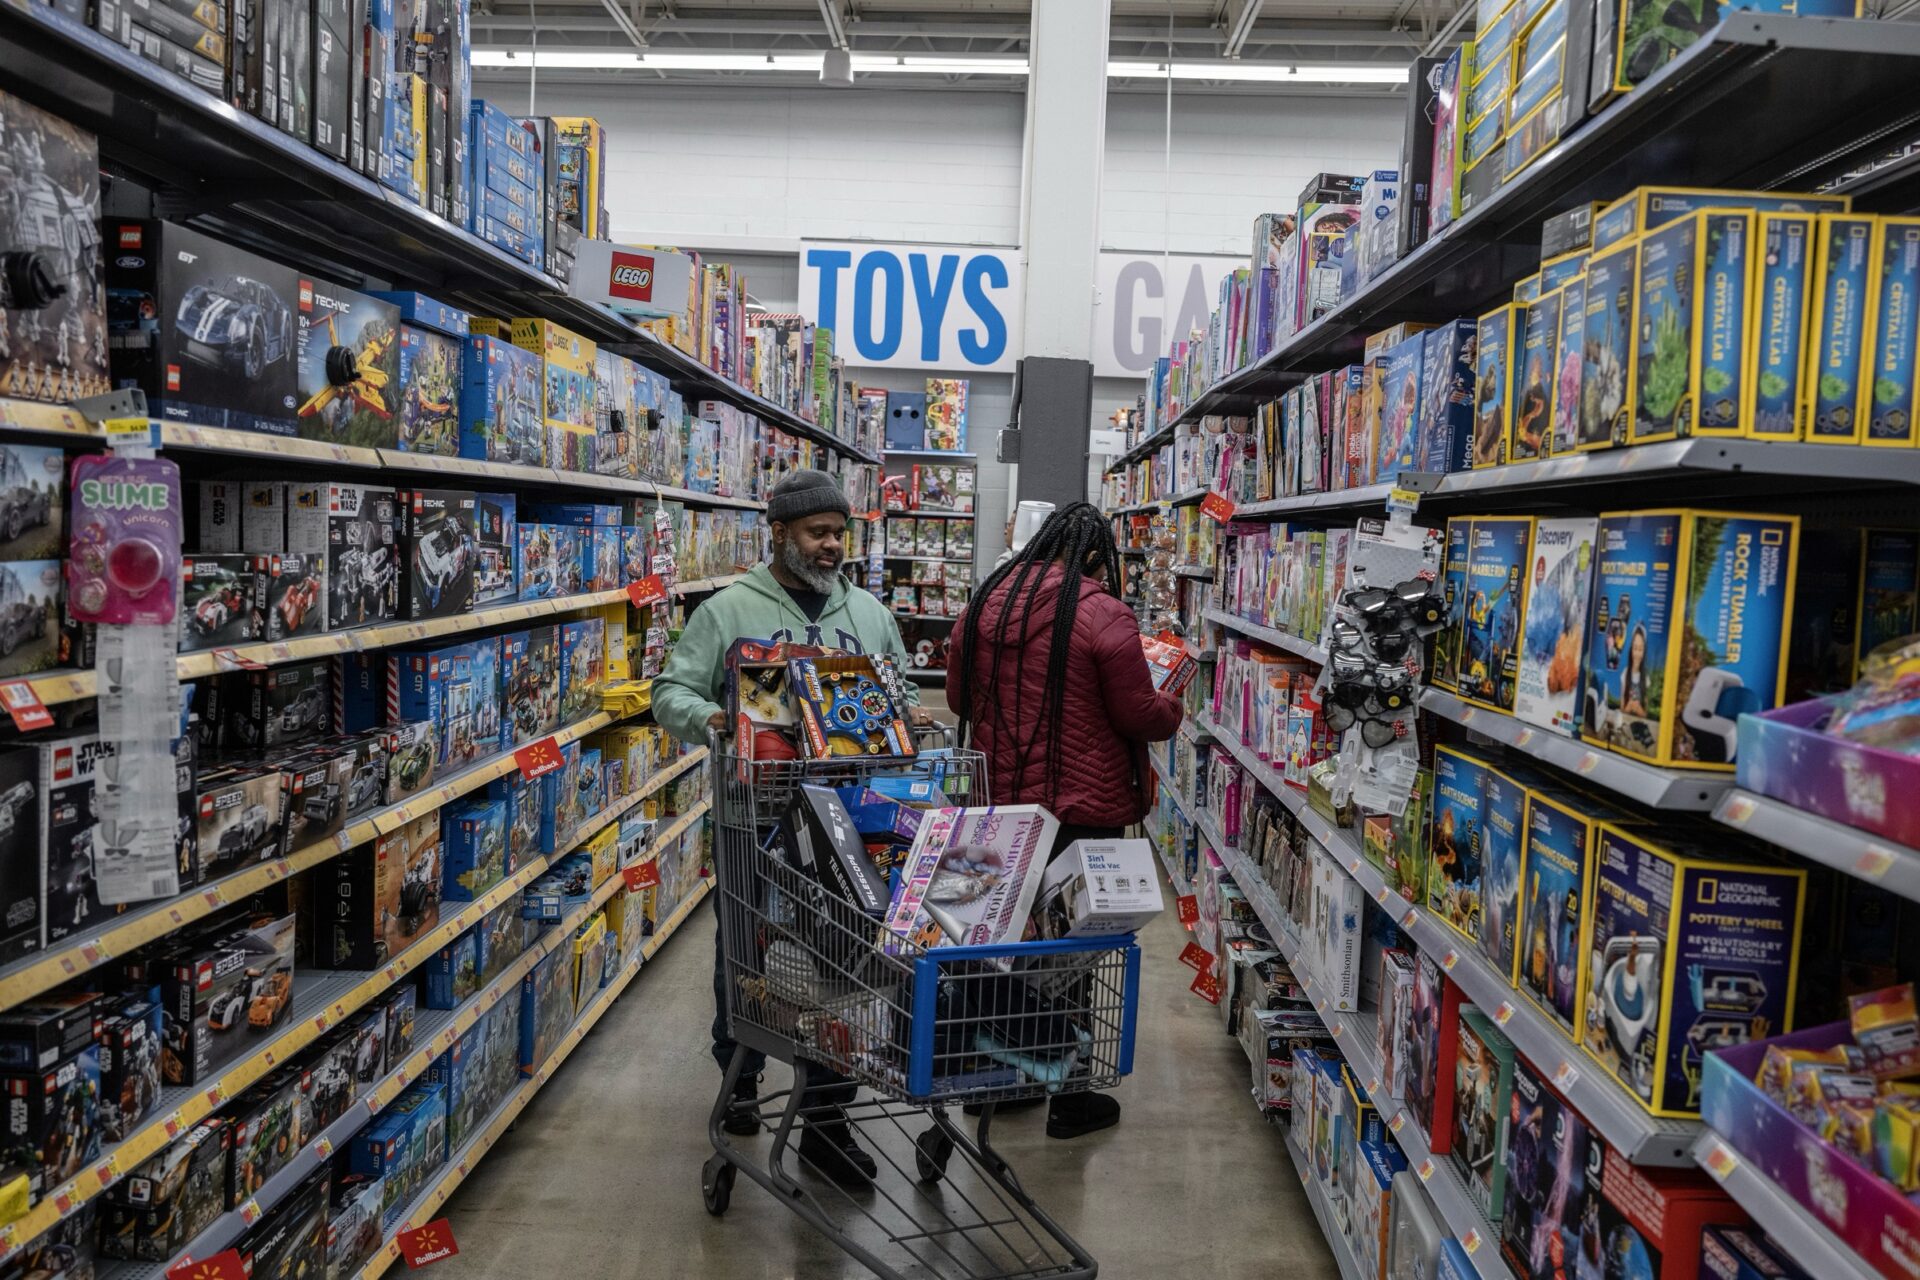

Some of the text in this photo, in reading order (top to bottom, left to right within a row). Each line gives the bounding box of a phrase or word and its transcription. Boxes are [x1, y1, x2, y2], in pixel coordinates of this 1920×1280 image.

[120, 232, 141, 241] LEGO
[178, 251, 198, 264] GT
[613, 266, 651, 288] LEGO
[315, 294, 350, 313] TECHNIC
[807, 248, 1009, 366] TOYS
[1711, 272, 1727, 361] CRYSTAL LAB
[1768, 276, 1786, 365] CRYSTAL LAB
[1830, 278, 1849, 367] CRYSTAL LAB
[1885, 282, 1903, 371] CRYSTAL LAB
[1462, 434, 1474, 468] Mega
[81, 480, 169, 511] SLIME
[340, 489, 357, 500] STAR
[424, 499, 445, 508] TECHNIC
[123, 514, 169, 528] unicorn
[1537, 526, 1575, 550] Discovery
[1717, 551, 1734, 644] EXPLORER SERIES
[1726, 533, 1752, 664] ROCK TUMBLER
[413, 674, 423, 694] CITY
[77, 741, 115, 760] STAR
[529, 760, 560, 777] Rollback
[215, 791, 243, 808] SPEED
[260, 844, 278, 860] 007
[985, 820, 1031, 920] FASHION SHOW
[1719, 881, 1768, 895] NATIONAL
[1625, 890, 1648, 917] WHEEL
[1717, 892, 1781, 907] GEOGRAPHIC
[1688, 912, 1784, 931] POTTERY WHEEL
[1687, 934, 1783, 951] REVOLUTIONARY
[1701, 945, 1768, 959] ARM TOOLS
[215, 949, 245, 974] SPEED
[1340, 938, 1353, 998] Smithsonian
[179, 984, 190, 1022] SPEED
[255, 1226, 287, 1264] TECHNIC
[414, 1247, 451, 1265] Rollback
